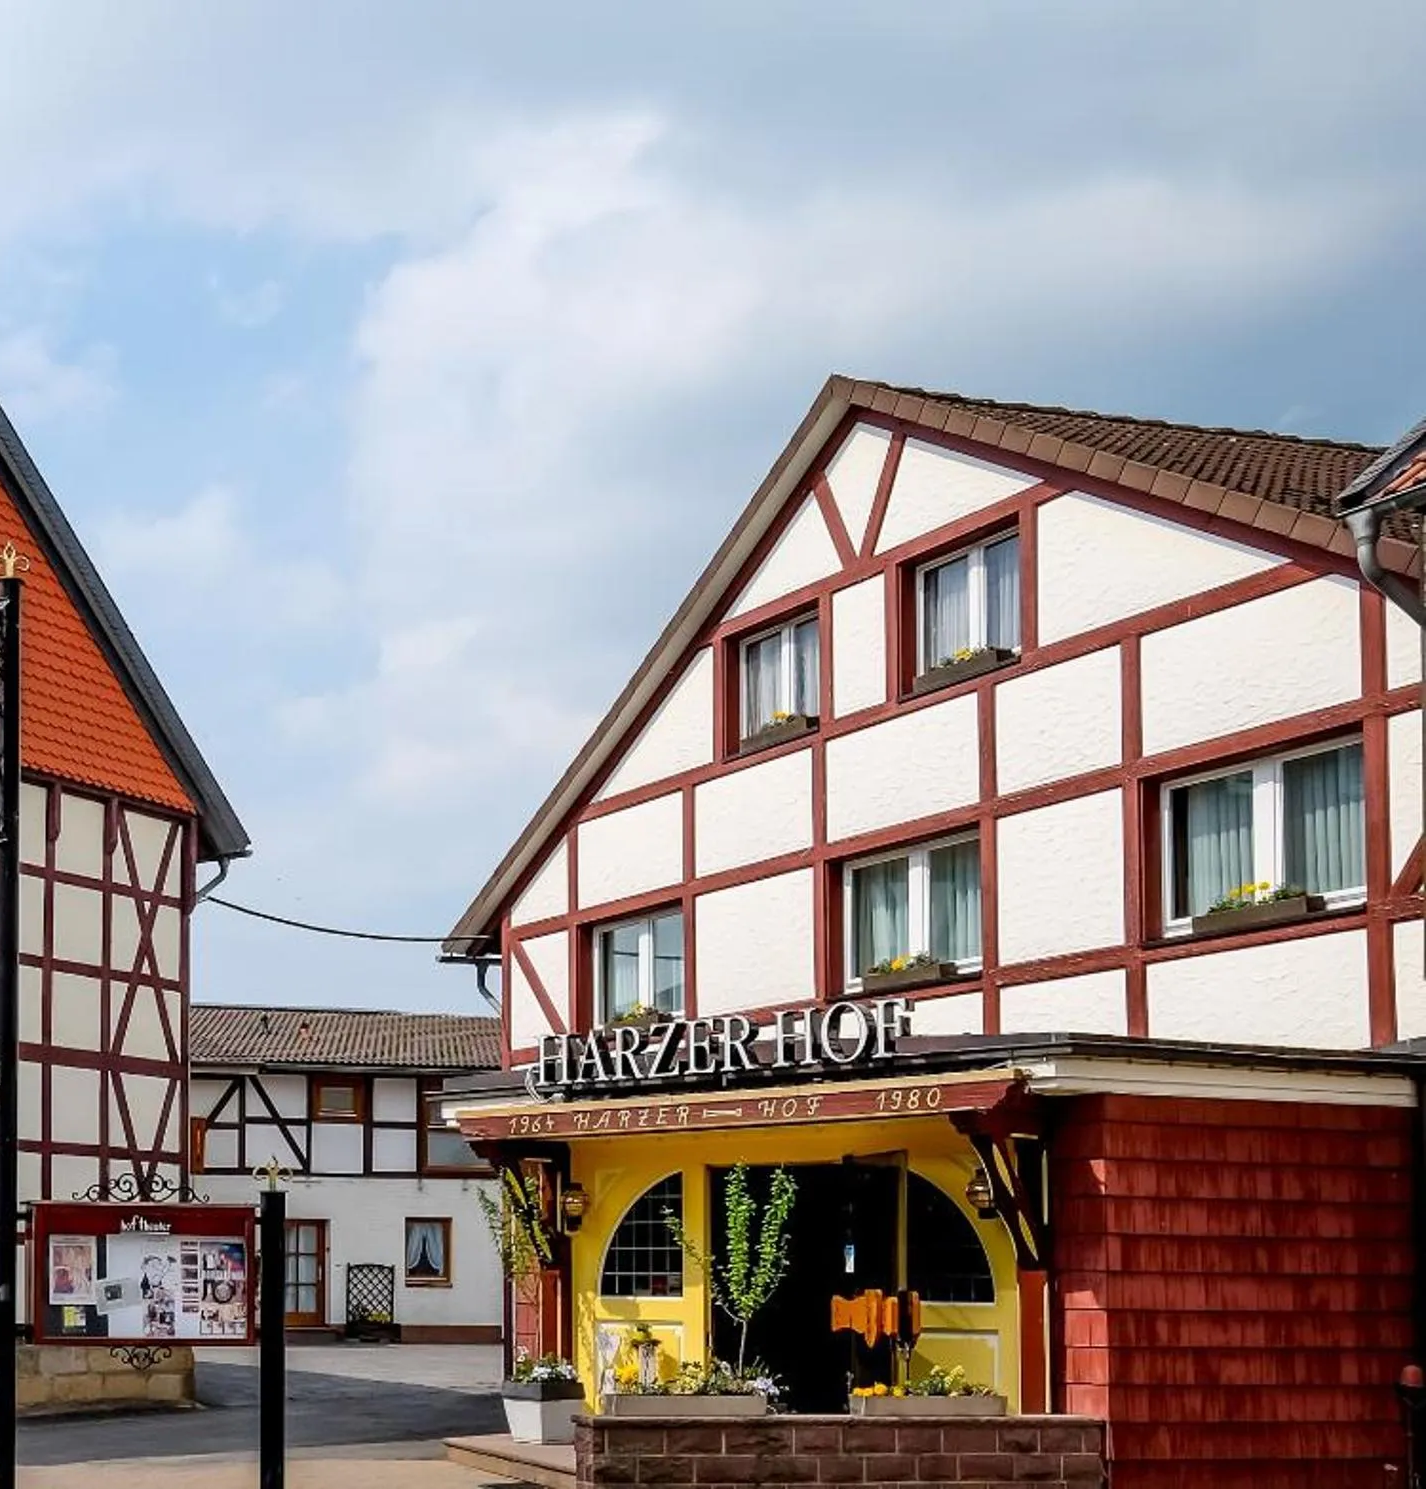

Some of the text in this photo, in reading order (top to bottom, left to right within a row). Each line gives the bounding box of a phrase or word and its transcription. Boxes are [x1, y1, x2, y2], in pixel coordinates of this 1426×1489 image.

[536, 998, 913, 1086] HARZER HOF
[508, 1088, 941, 1134] 1964 HARZER HOF 1980
